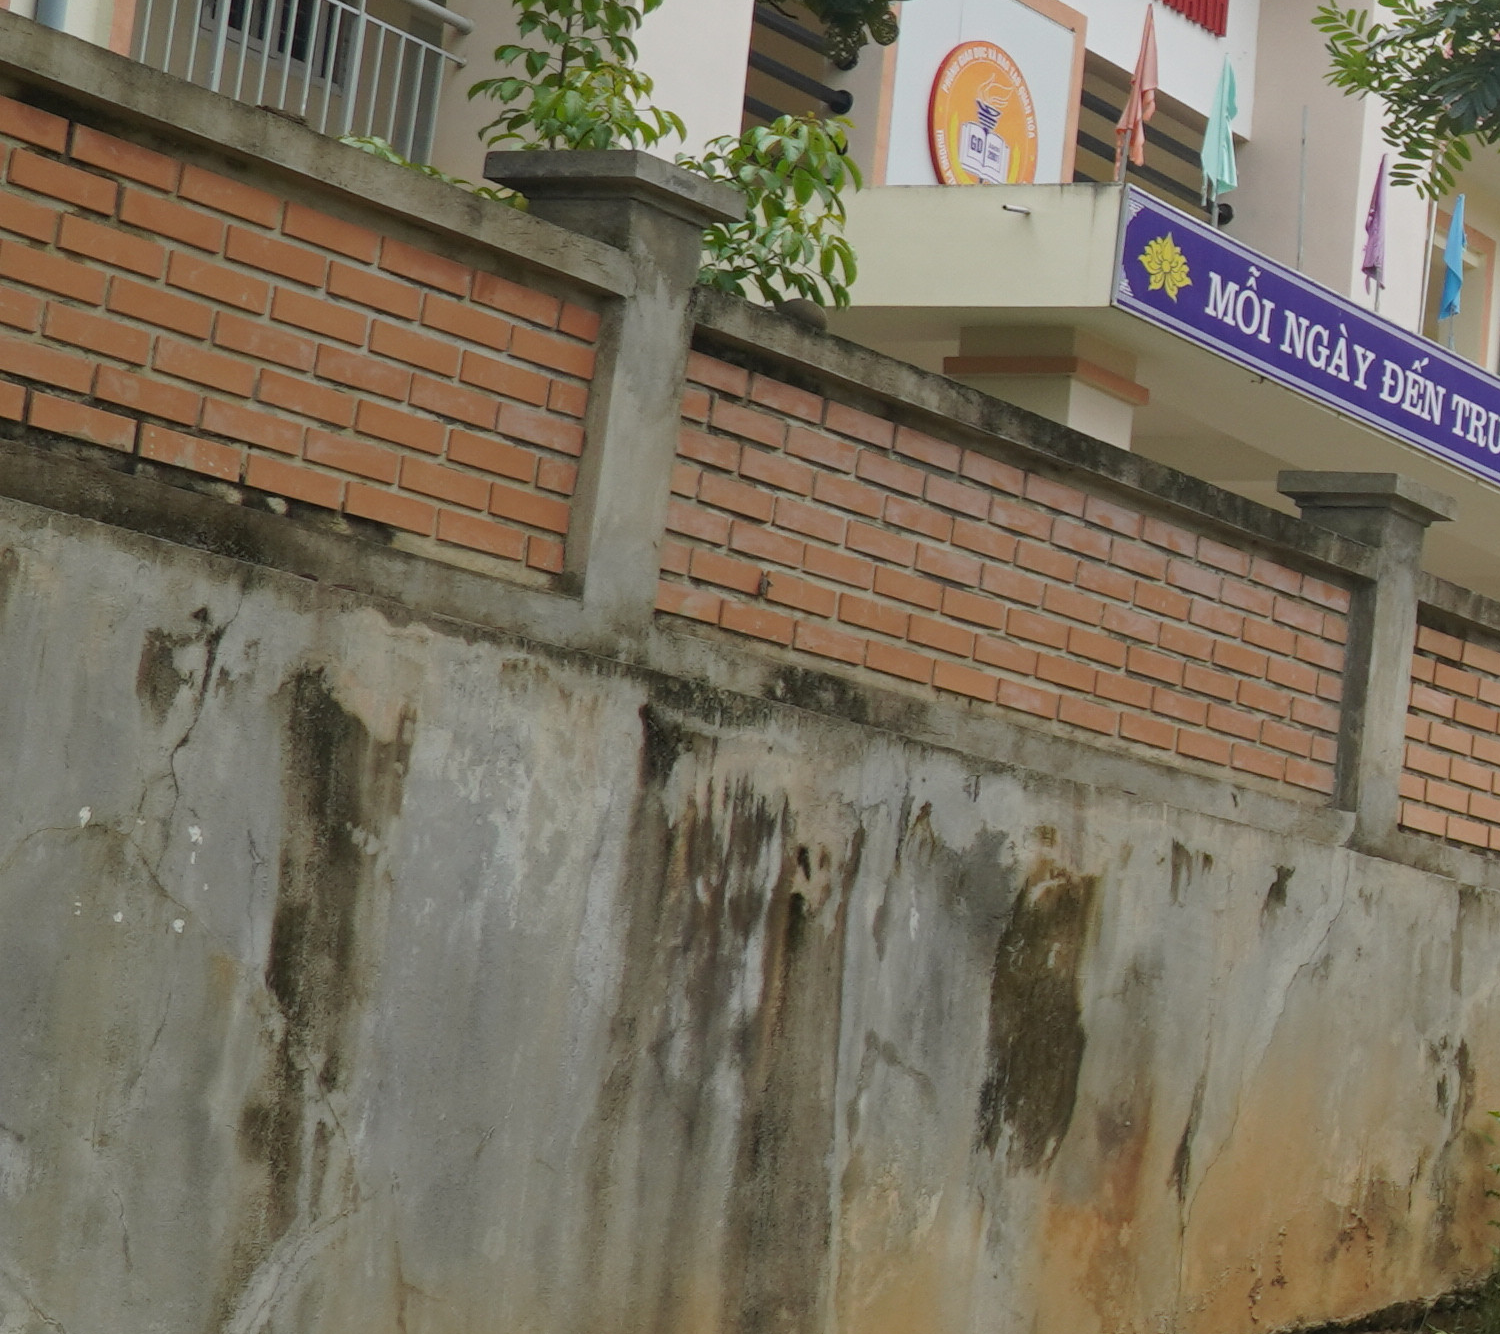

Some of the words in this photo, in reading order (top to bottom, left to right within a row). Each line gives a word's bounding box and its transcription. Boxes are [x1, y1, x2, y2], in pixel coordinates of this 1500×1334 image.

[1204, 266, 1275, 344] MỖI
[1280, 308, 1376, 391] NGÀY
[1379, 357, 1447, 426] ĐẾN
